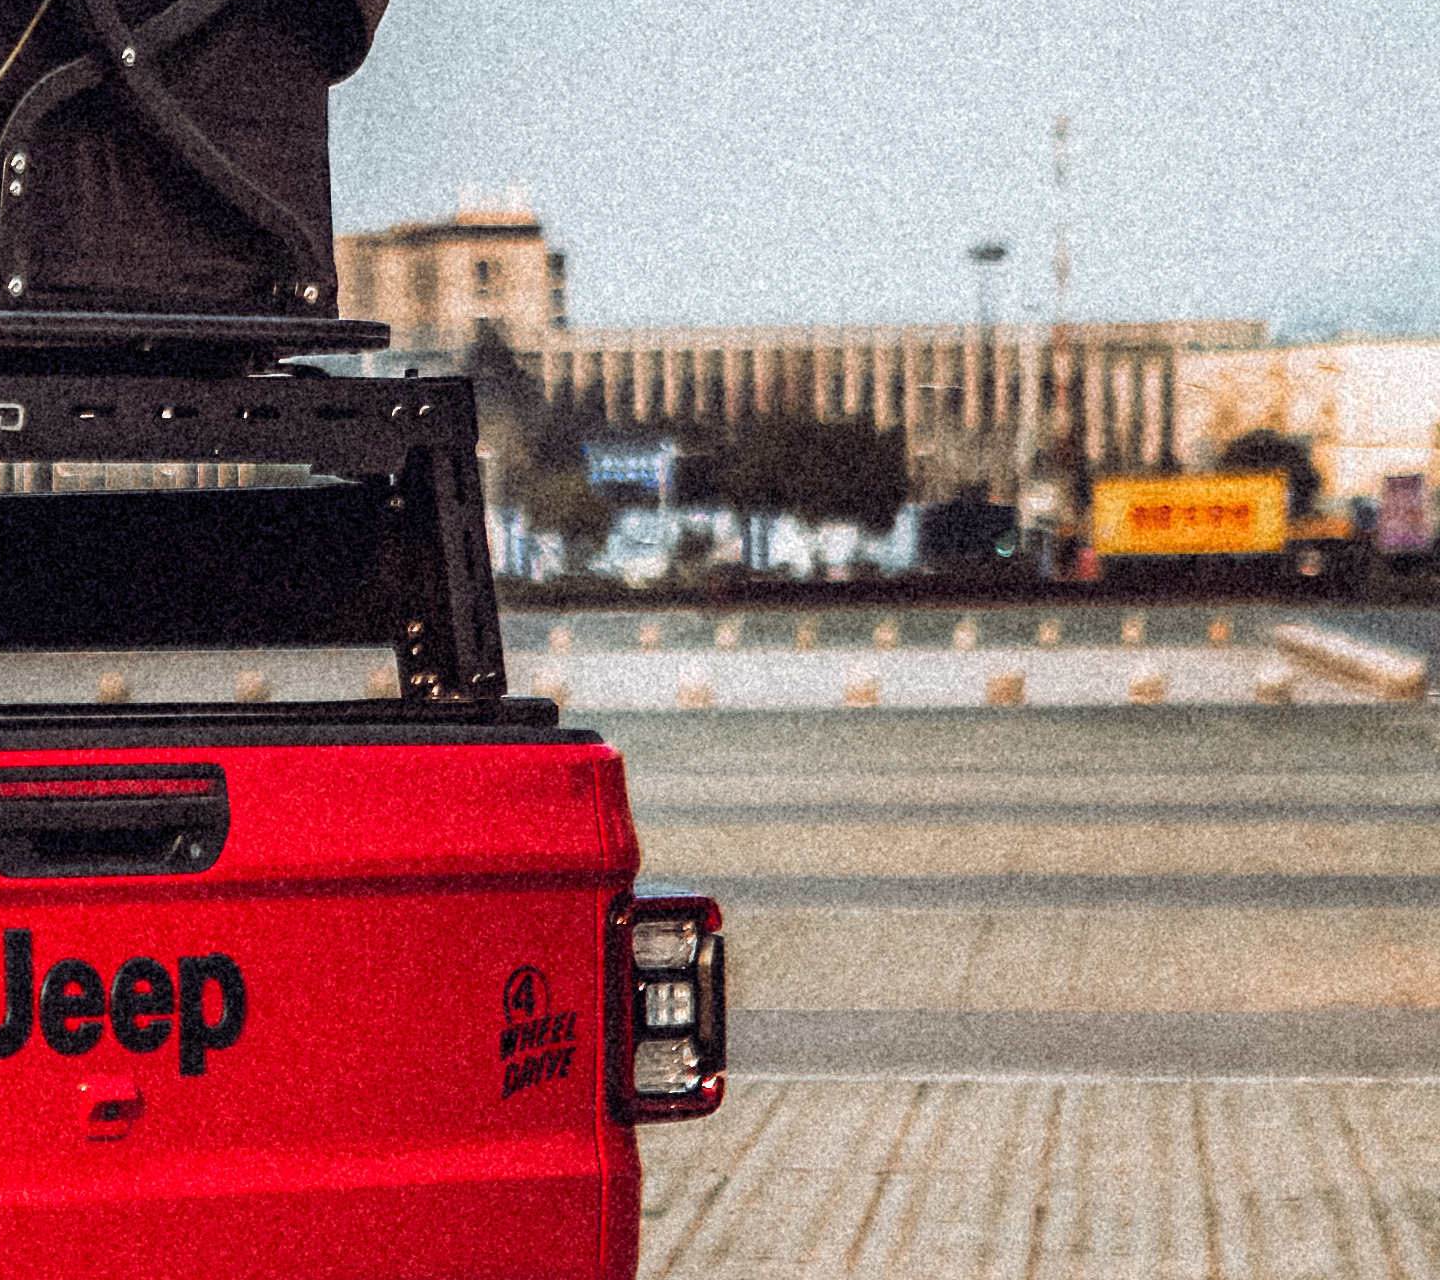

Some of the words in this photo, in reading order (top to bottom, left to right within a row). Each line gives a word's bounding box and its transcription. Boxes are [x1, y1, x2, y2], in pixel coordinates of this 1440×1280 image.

[512, 973, 535, 1017] 4
[500, 1011, 578, 1061] WHEEL
[501, 1046, 576, 1100] DRIVE
